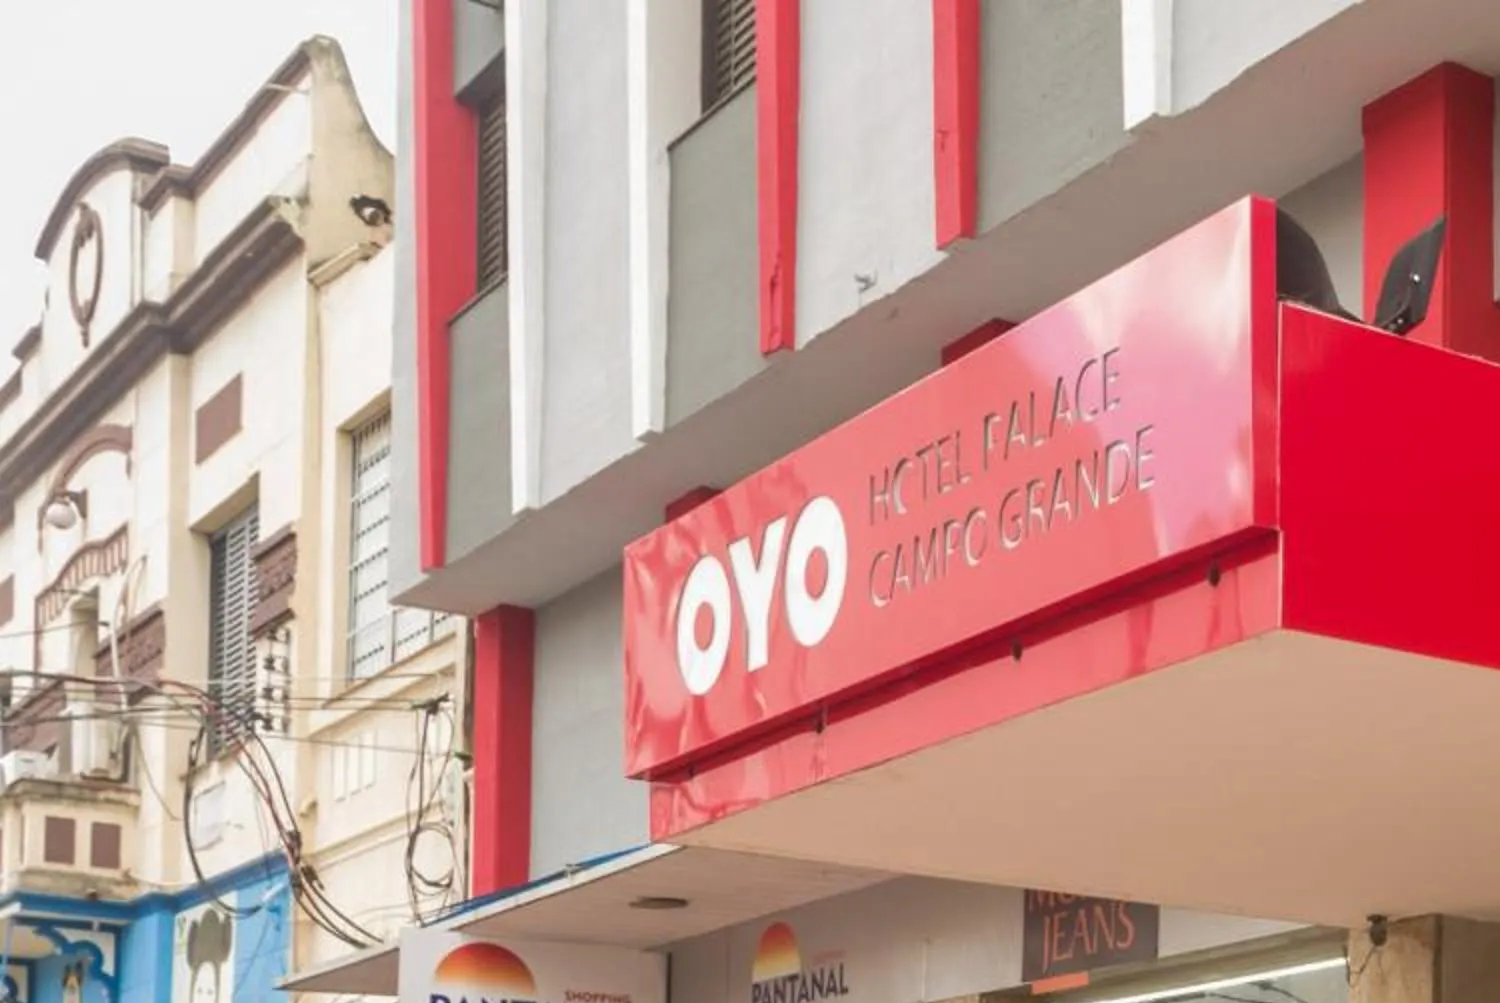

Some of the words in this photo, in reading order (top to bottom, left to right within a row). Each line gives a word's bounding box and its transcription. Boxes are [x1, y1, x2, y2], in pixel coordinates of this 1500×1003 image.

[868, 506, 989, 608] CAMPO
[999, 424, 1156, 552] GRANDE
[869, 430, 971, 526] HOTEL
[983, 346, 1121, 474] PALACE
[676, 495, 848, 695] OYO
[1042, 902, 1136, 974] JEANS
